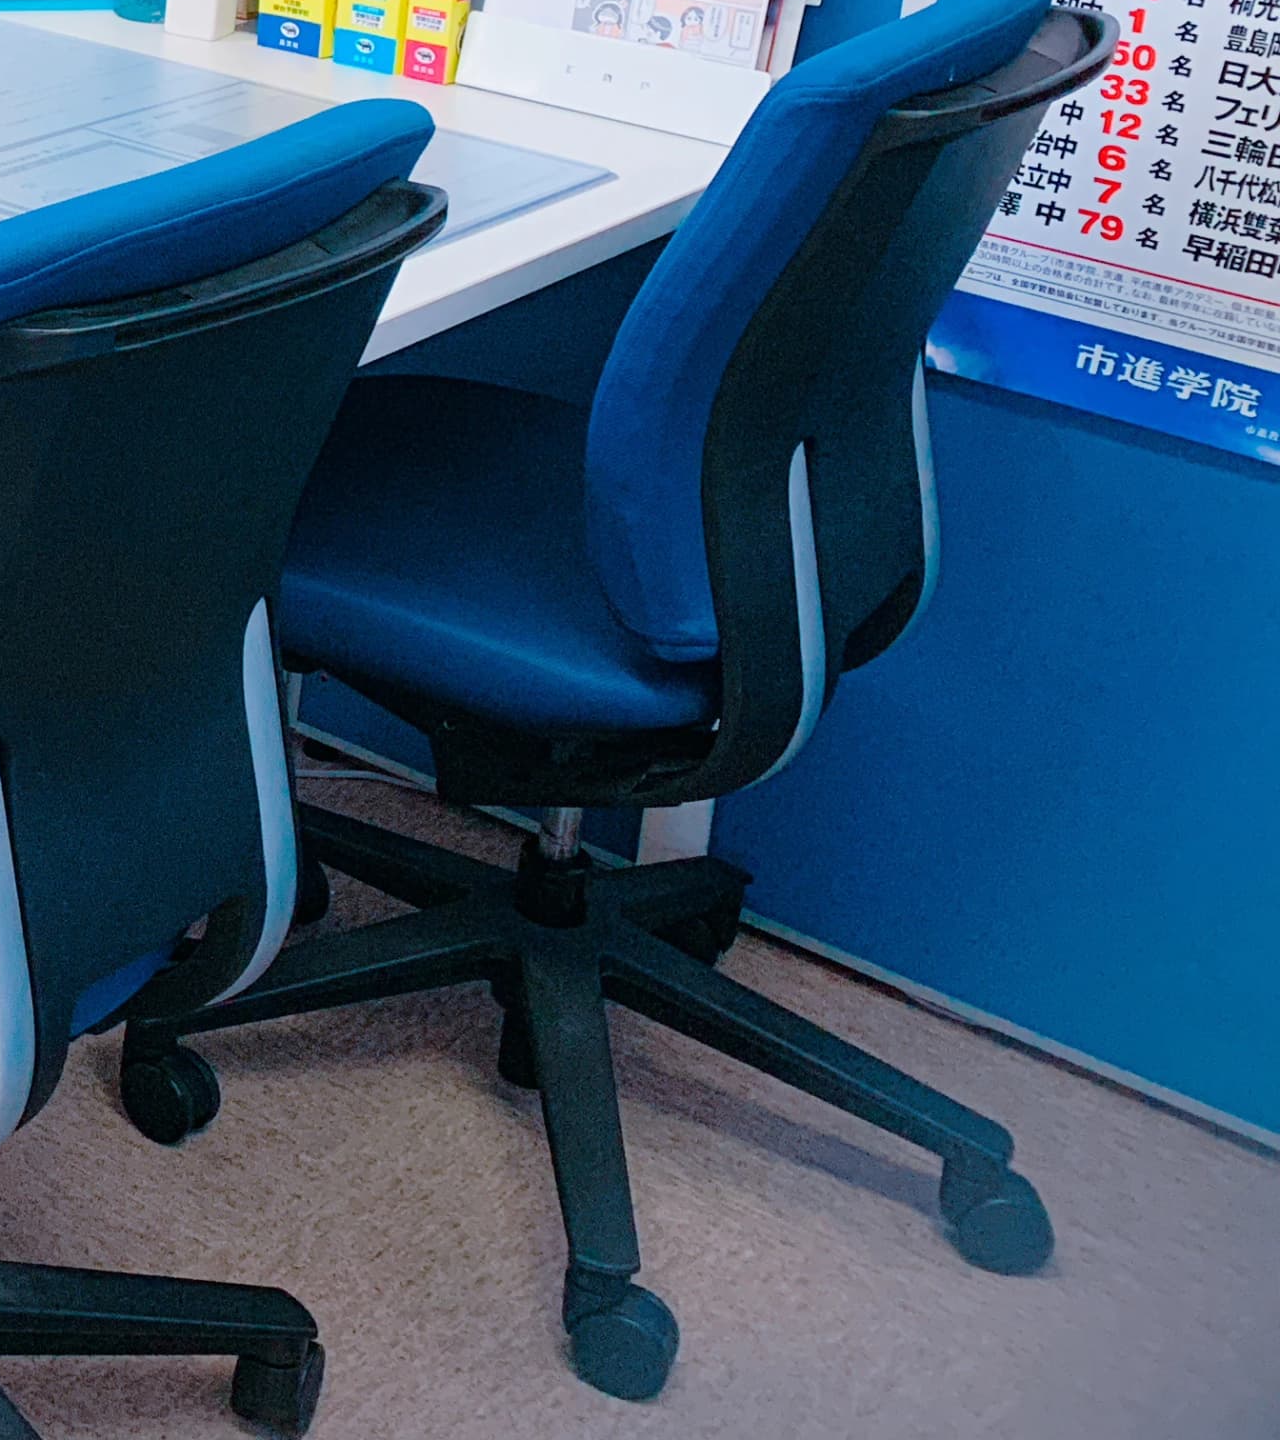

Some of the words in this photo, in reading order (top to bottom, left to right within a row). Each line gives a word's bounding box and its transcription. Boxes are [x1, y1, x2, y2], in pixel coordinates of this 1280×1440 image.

[1128, 7, 1148, 34] 1
[1175, 20, 1201, 44] 名
[1100, 74, 1150, 106] 33
[1162, 90, 1186, 114] 名
[1100, 109, 1143, 141] 12
[1155, 124, 1180, 148] 名
[1097, 144, 1129, 172] 6
[1093, 176, 1123, 205] 7
[1142, 193, 1167, 217] 名
[1077, 208, 1125, 242] 79
[1136, 226, 1161, 250] 名
[1182, 234, 1280, 279] 早稲田
[1075, 342, 1264, 419] 市進学院
